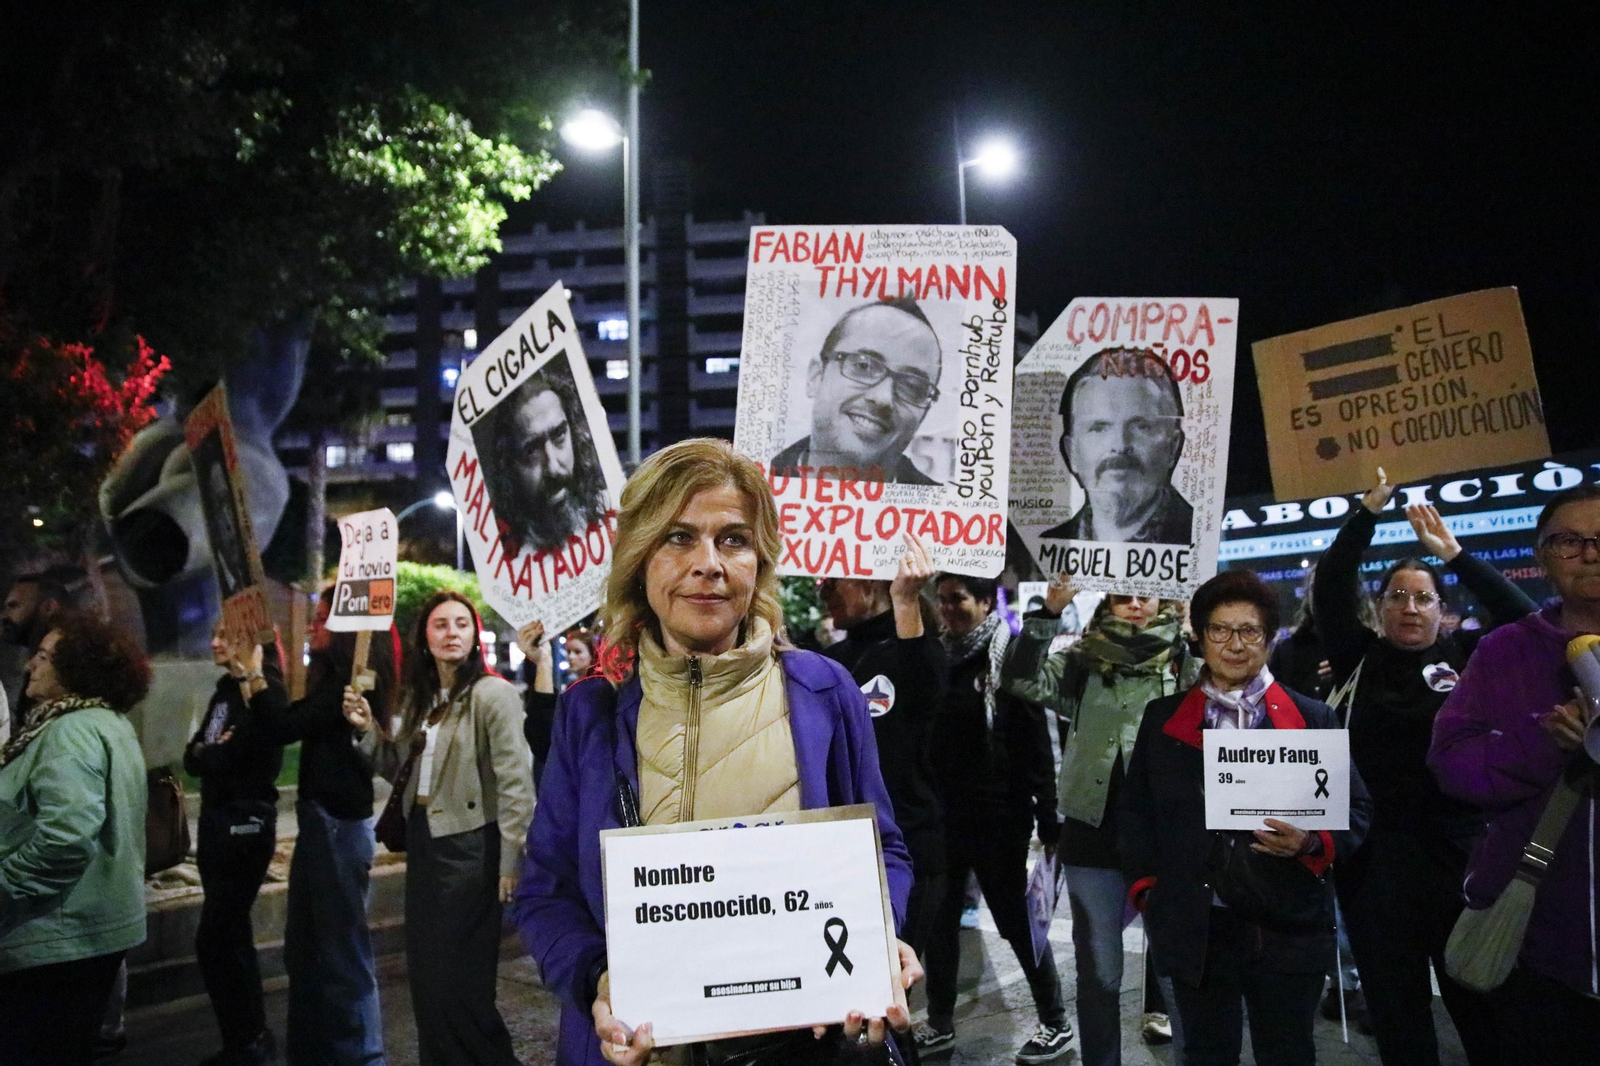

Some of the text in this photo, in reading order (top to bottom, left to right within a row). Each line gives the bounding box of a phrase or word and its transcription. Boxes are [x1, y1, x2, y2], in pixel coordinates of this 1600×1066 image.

[753, 231, 864, 264] FABIAN
[815, 264, 1007, 302] THYLMANN
[1066, 302, 1233, 347] COMPRA-
[1412, 312, 1470, 344] EL
[457, 309, 566, 425] EL CIGALA
[1099, 342, 1211, 385] NIÑOS
[1405, 330, 1504, 382] GÉNERO
[947, 314, 984, 499] dueño Pornhub
[983, 393, 1004, 408] y
[1290, 376, 1479, 431] ES OPRESIÓN,
[1347, 382, 1546, 453] NO COEDUCACIÓN
[756, 462, 884, 503] UTERO
[1008, 496, 1053, 508] músico
[344, 520, 389, 560] Deja a
[779, 503, 1005, 547] EXPLOTADOR
[344, 555, 391, 577] tu novio
[779, 536, 873, 576] XUAL
[872, 544, 887, 554] NO
[1039, 543, 1116, 578] MIGUEL
[1126, 543, 1195, 583] BOSÉ
[1217, 747, 1322, 765] Audrey Fang,
[1218, 772, 1233, 784] 39
[633, 864, 715, 888] Nombre
[635, 889, 834, 924] desconocido, 62 años
[710, 979, 797, 997] asesinada por su hijo
